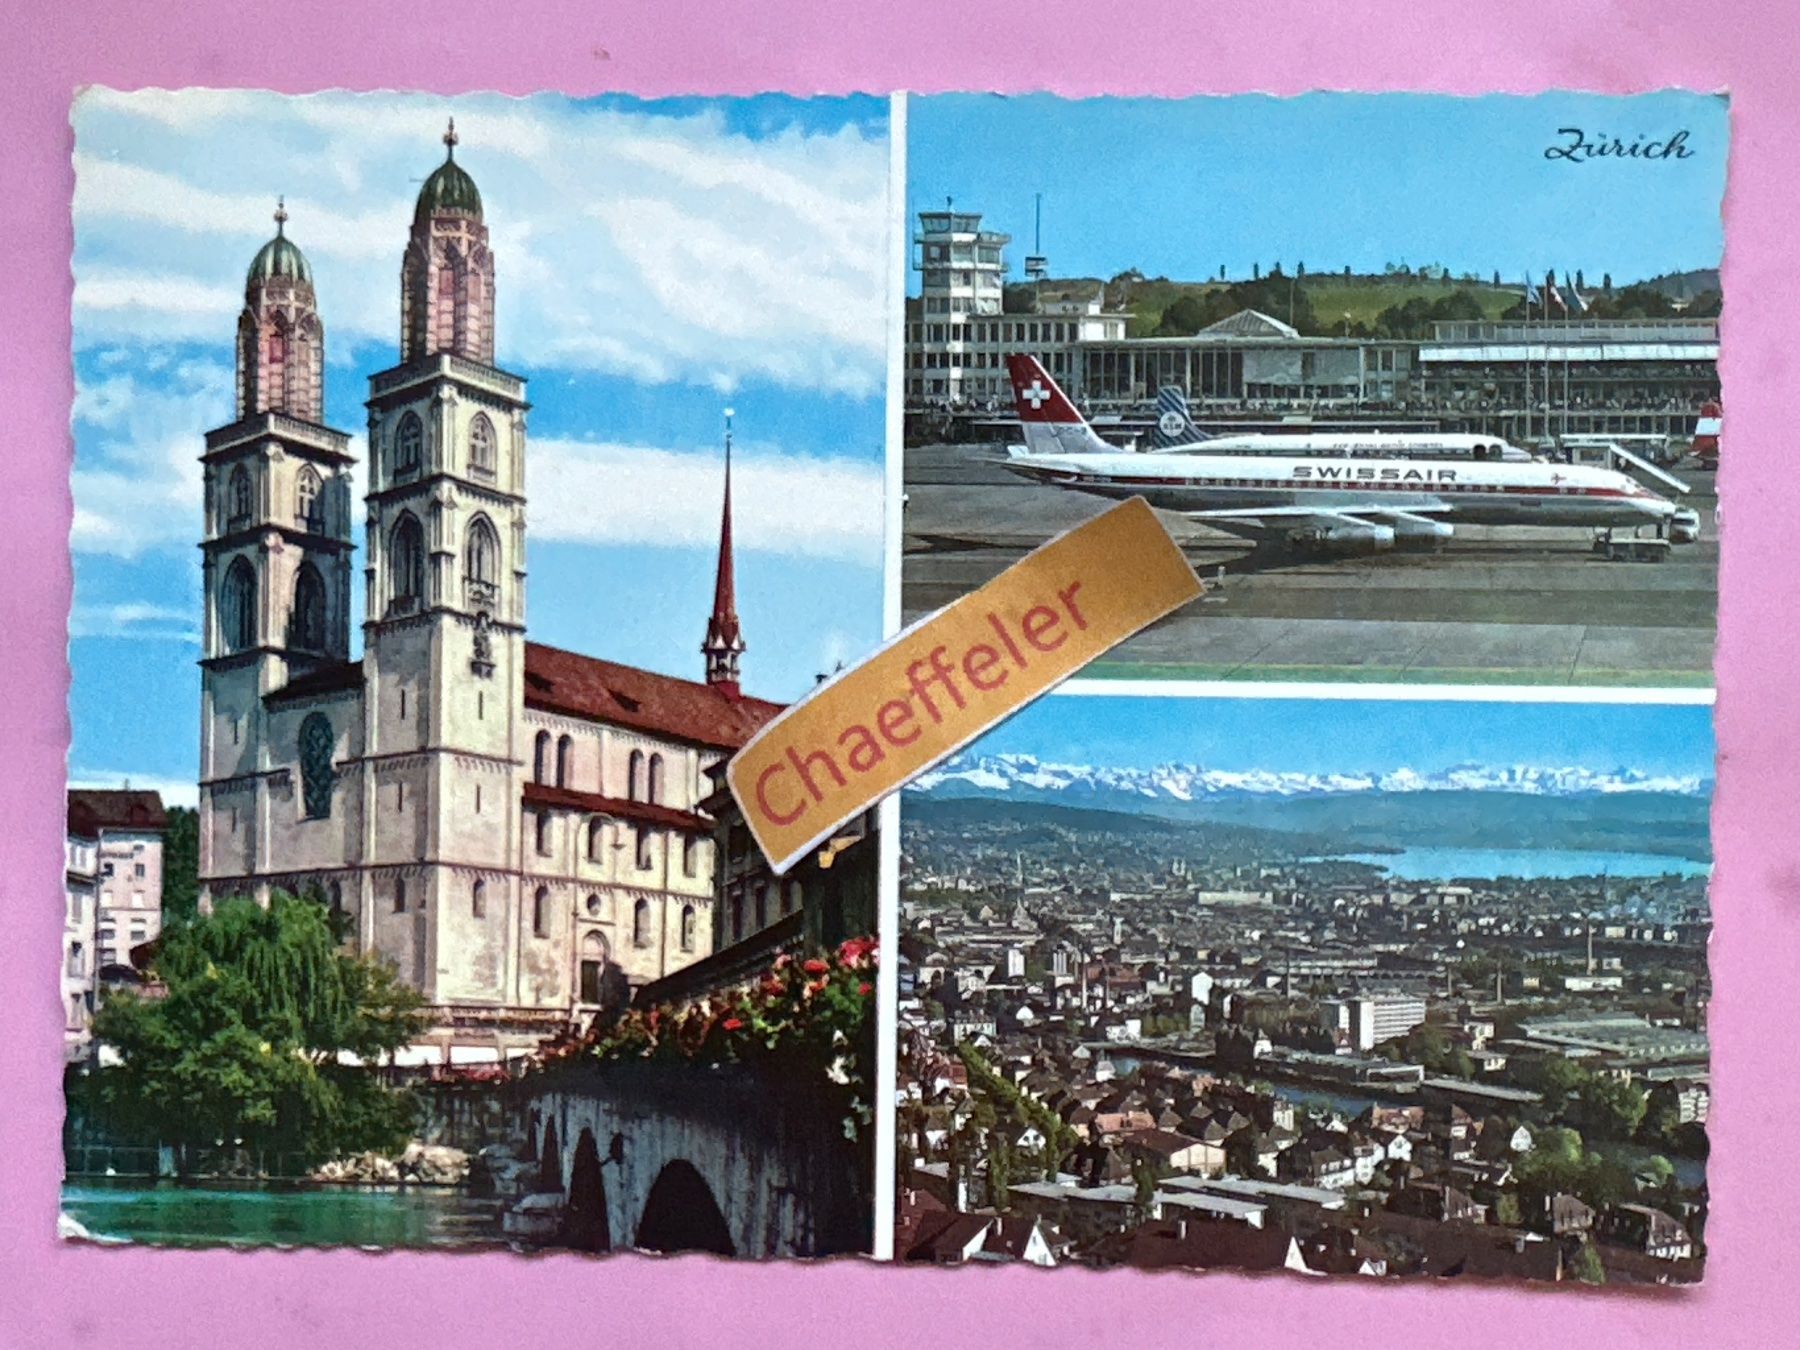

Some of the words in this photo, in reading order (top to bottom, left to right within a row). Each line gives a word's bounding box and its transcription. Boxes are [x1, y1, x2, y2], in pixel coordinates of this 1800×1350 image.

[1544, 129, 1695, 163] Zürich
[1292, 465, 1457, 482] SWISSAIR
[754, 580, 1088, 829] Chaeffeler
